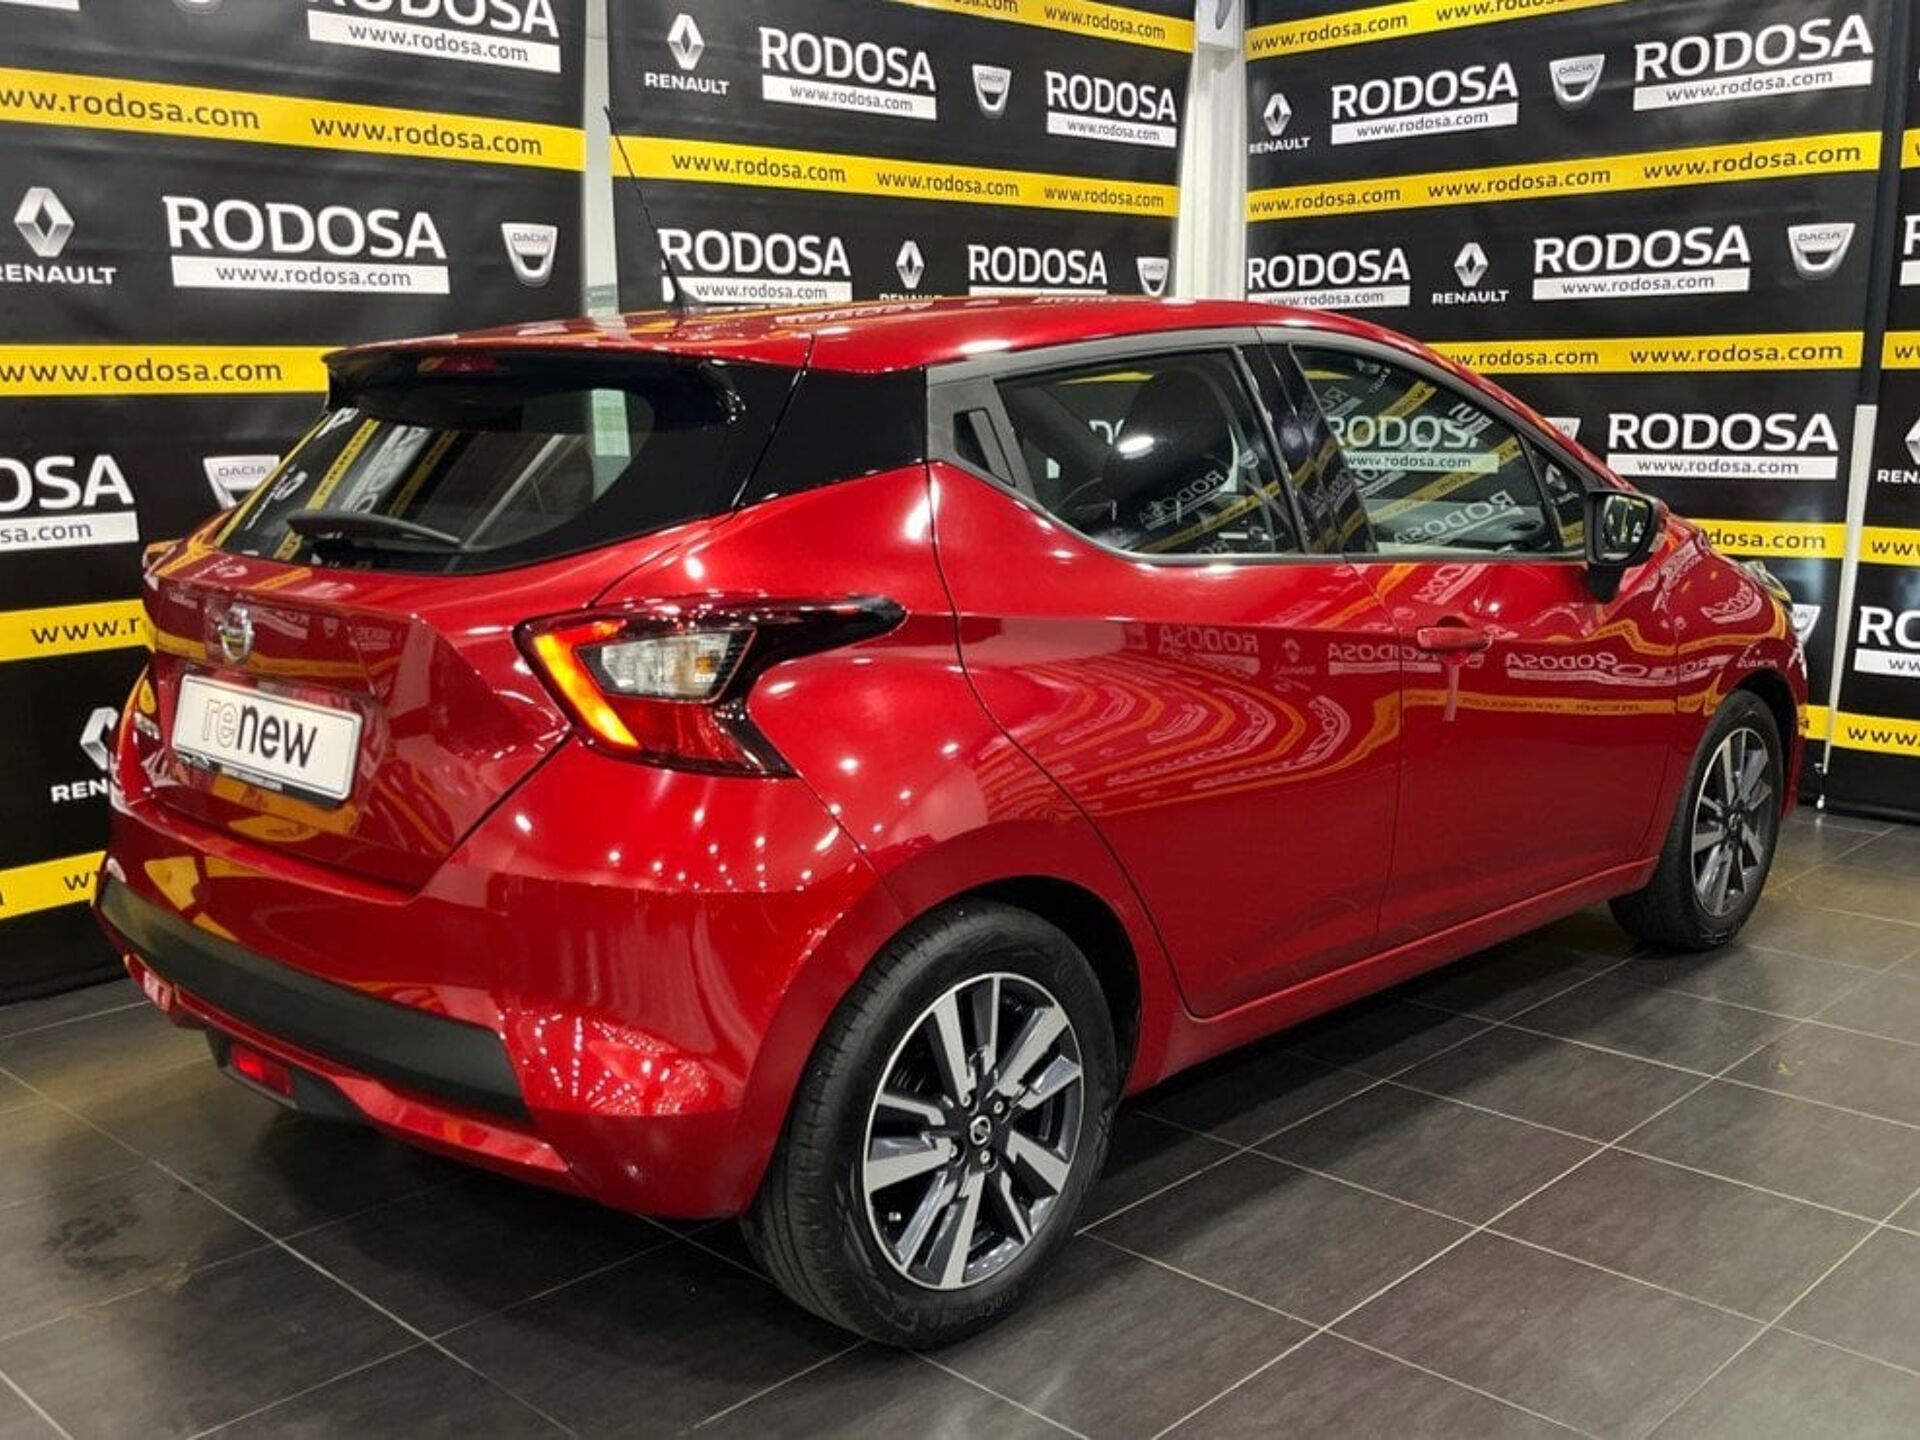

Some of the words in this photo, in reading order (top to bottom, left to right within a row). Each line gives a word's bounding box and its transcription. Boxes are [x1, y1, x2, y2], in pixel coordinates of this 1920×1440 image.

[1044, 5, 1166, 40] www.rodosa.com
[1251, 13, 1408, 51] www.rodosa.com
[348, 24, 529, 62] www.rodosa.com
[758, 26, 937, 91] RODOSA
[1634, 14, 1874, 83] RODOSA
[644, 72, 730, 96] RENAULT
[790, 84, 913, 112] www.rodosa.com
[1045, 70, 1177, 123] RODOSA
[1331, 61, 1520, 120] RODOSA
[1666, 70, 1833, 101] www.rodosa.com
[311, 117, 542, 156] www.rodosa.com
[1067, 120, 1160, 141] www.rodosa.com
[1357, 110, 1488, 137] www.rodosa.com
[1250, 137, 1311, 154] RENAULT
[672, 153, 846, 184] www.rodosa.com
[1643, 147, 1860, 180] www.rodosa.com
[877, 170, 1020, 198] www.rodosa.com
[1044, 184, 1164, 209] www.rodosa.com
[1428, 167, 1611, 197] www.rodosa.com
[1249, 186, 1401, 214] www.rodosa.com
[162, 195, 447, 259] RODOSA
[657, 228, 851, 277] RODOSA
[968, 244, 1109, 285] RODOSA
[1533, 225, 1751, 274] RODOSA
[215, 266, 411, 287] www.rodosa.com
[1248, 247, 1411, 289] RODOSA
[696, 281, 827, 300] www.rodosa.com
[1432, 290, 1509, 305] RENAULT
[1562, 274, 1714, 295] www.rodosa.com
[1630, 344, 1842, 364] www.rodosa.com
[0, 358, 282, 382] www.rodosa.com
[1608, 413, 1838, 451] RODOSA
[218, 466, 267, 477] DACIA
[1637, 458, 1799, 475] www.rodosa.com
[202, 699, 318, 768] renew
